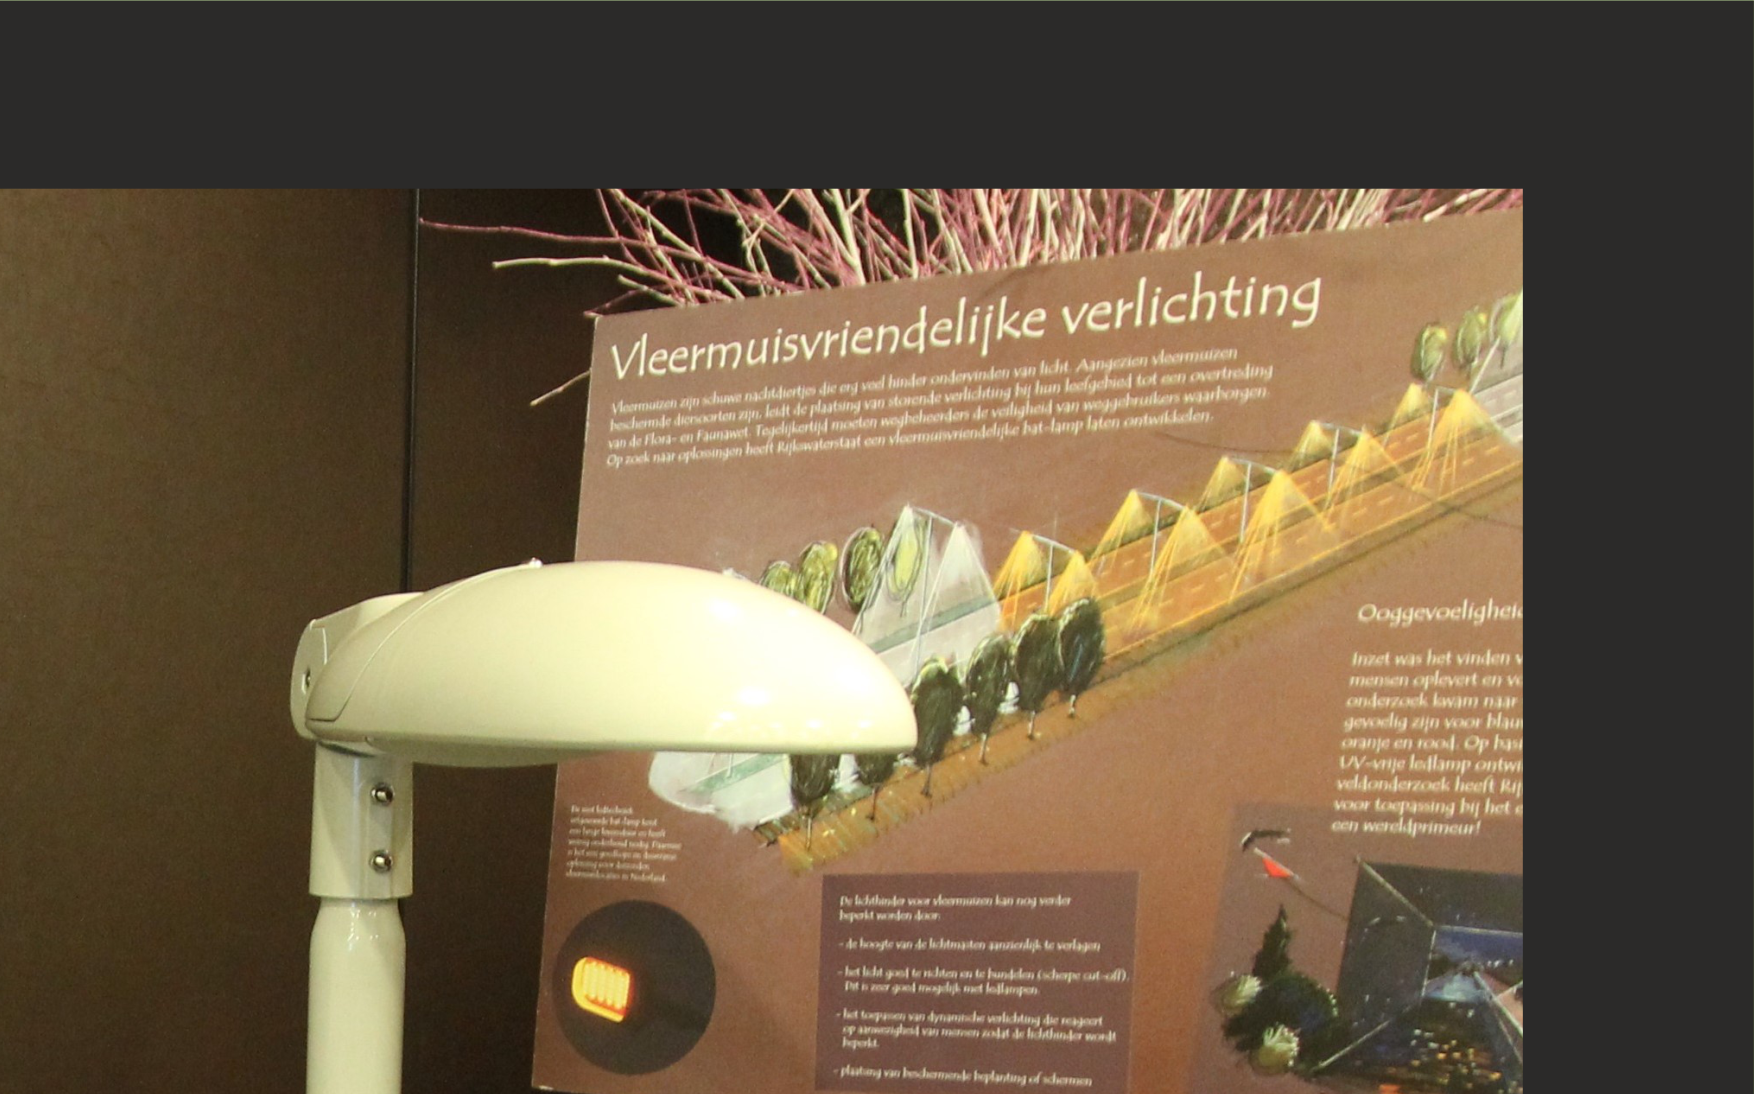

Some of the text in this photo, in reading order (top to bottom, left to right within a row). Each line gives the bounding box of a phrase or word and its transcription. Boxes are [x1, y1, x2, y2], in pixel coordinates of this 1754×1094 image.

[610, 270, 1322, 381] Vleermuisvriendelijke verlichting
[610, 397, 677, 414] Vleermuizen
[679, 394, 699, 410] zijn
[701, 391, 741, 406] schuwe
[743, 385, 815, 402] nachtdiertjes
[817, 382, 836, 396] die
[838, 383, 858, 396] erg
[860, 377, 885, 392] veel
[886, 375, 926, 390] hinder
[928, 368, 1009, 386] ondervinden
[1012, 368, 1035, 379] van
[1075, 356, 1147, 375] Aangezien
[1150, 349, 1237, 367] vleermuizen
[608, 415, 670, 432] beschermde
[672, 411, 735, 427] diersoorten
[764, 405, 790, 419] leidt
[792, 403, 806, 417] de
[808, 400, 860, 419] plaatsing
[862, 400, 884, 411] van
[886, 392, 941, 409] storende
[942, 388, 1010, 404] verlichting
[1013, 385, 1030, 401] bij
[1033, 383, 1060, 397] hun
[1063, 376, 1132, 396] leefgebied
[1134, 375, 1156, 389] tot
[1159, 375, 1186, 386] een
[1188, 366, 1272, 384] overtreding
[754, 409, 969, 439] Tegelijkertijd moeten wegbeheerders
[605, 452, 622, 468] Op
[624, 450, 650, 464] zoek
[652, 452, 674, 462] naar
[676, 445, 742, 463] oplossingen
[744, 441, 773, 456] heeft
[775, 436, 861, 456] Rijkswaterstaat
[862, 436, 885, 447] een
[887, 423, 1018, 445] vleermuisvriendelijke
[1021, 420, 1083, 435] bat-lamp
[1085, 418, 1120, 431] laten
[1350, 649, 1510, 666] Inzet was het vinden
[1348, 670, 1502, 691] mensen oplevert en
[1345, 692, 1516, 708] onderzoek kwam naar
[1342, 712, 1481, 733] gevoelig zijn voor
[1340, 734, 1389, 754] oranje
[1392, 738, 1412, 750] en
[1462, 734, 1488, 755] Op
[1338, 753, 1470, 776] UV-vrije ledlamp
[1335, 775, 1495, 793] veldonderzoek heeft
[1332, 797, 1511, 818] voor toepassing bij het
[1330, 817, 1481, 838] een wereldprimeur!
